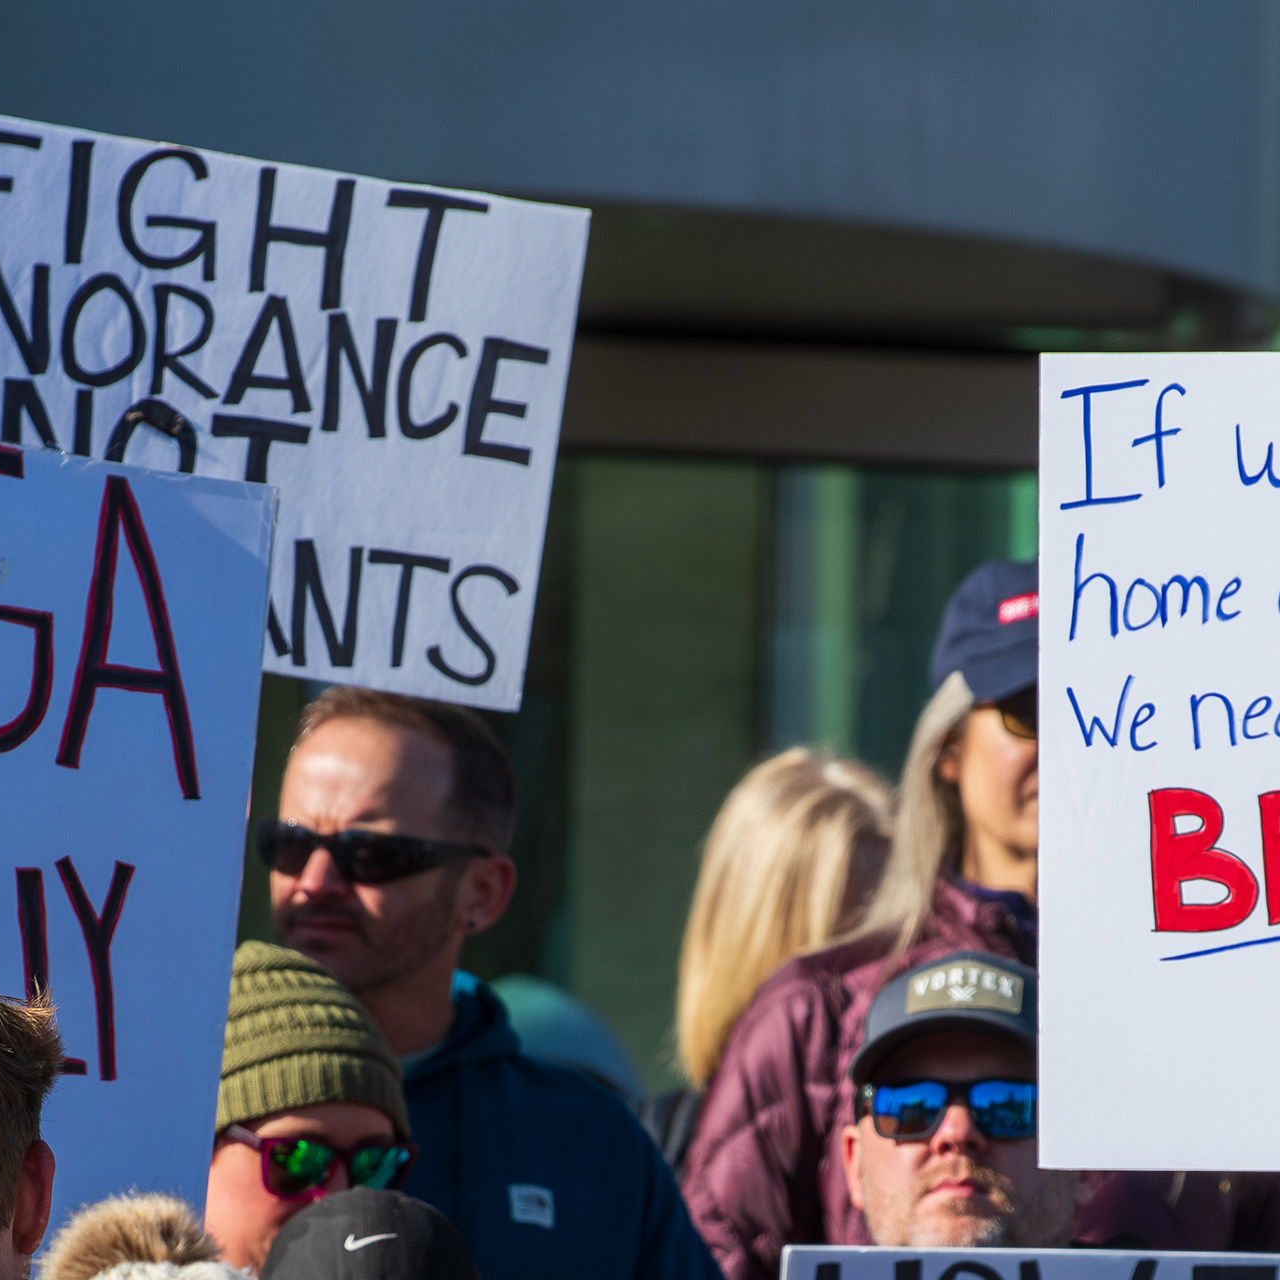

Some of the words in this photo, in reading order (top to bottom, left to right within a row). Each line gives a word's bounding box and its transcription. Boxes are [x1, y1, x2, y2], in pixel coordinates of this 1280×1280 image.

[1059, 377, 1186, 510] If
[1067, 532, 1245, 642] home
[913, 966, 1015, 999] VORTEX
